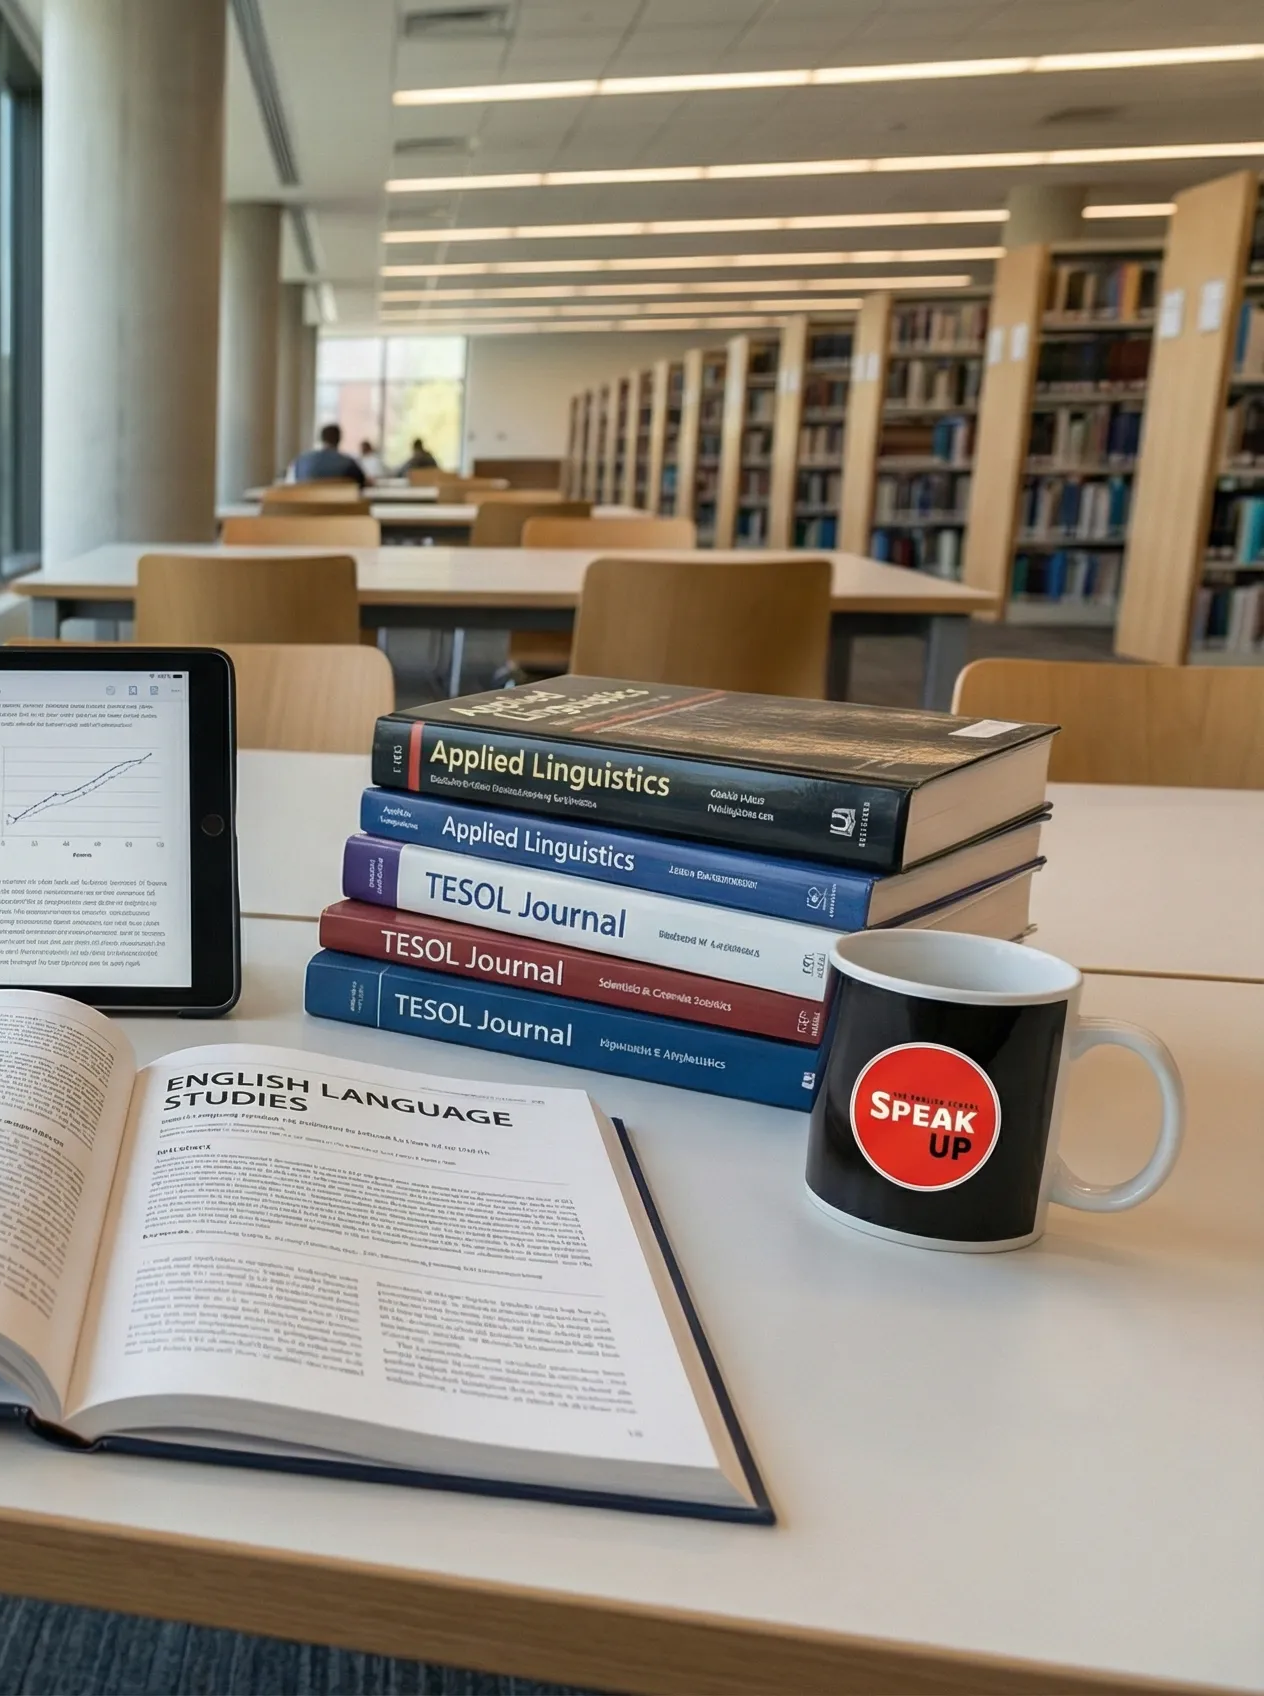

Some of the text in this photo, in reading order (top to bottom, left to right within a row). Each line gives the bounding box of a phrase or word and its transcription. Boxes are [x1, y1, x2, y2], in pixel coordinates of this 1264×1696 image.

[429, 739, 525, 776] Applied
[532, 752, 671, 798] Linguistics
[442, 816, 518, 846] Applied
[524, 831, 636, 872] Linguistics
[425, 872, 511, 914] TESOL
[518, 891, 627, 939] Journal
[381, 930, 564, 986] TESOL Journal
[394, 993, 472, 1028] TESOL
[477, 1009, 572, 1047] Journal
[163, 1090, 308, 1112] STUDIES
[167, 1072, 309, 1093] ENGLISH
[321, 1083, 513, 1127] LANGUAGE
[870, 1091, 977, 1134] SPEAK
[929, 1133, 972, 1160] UP
